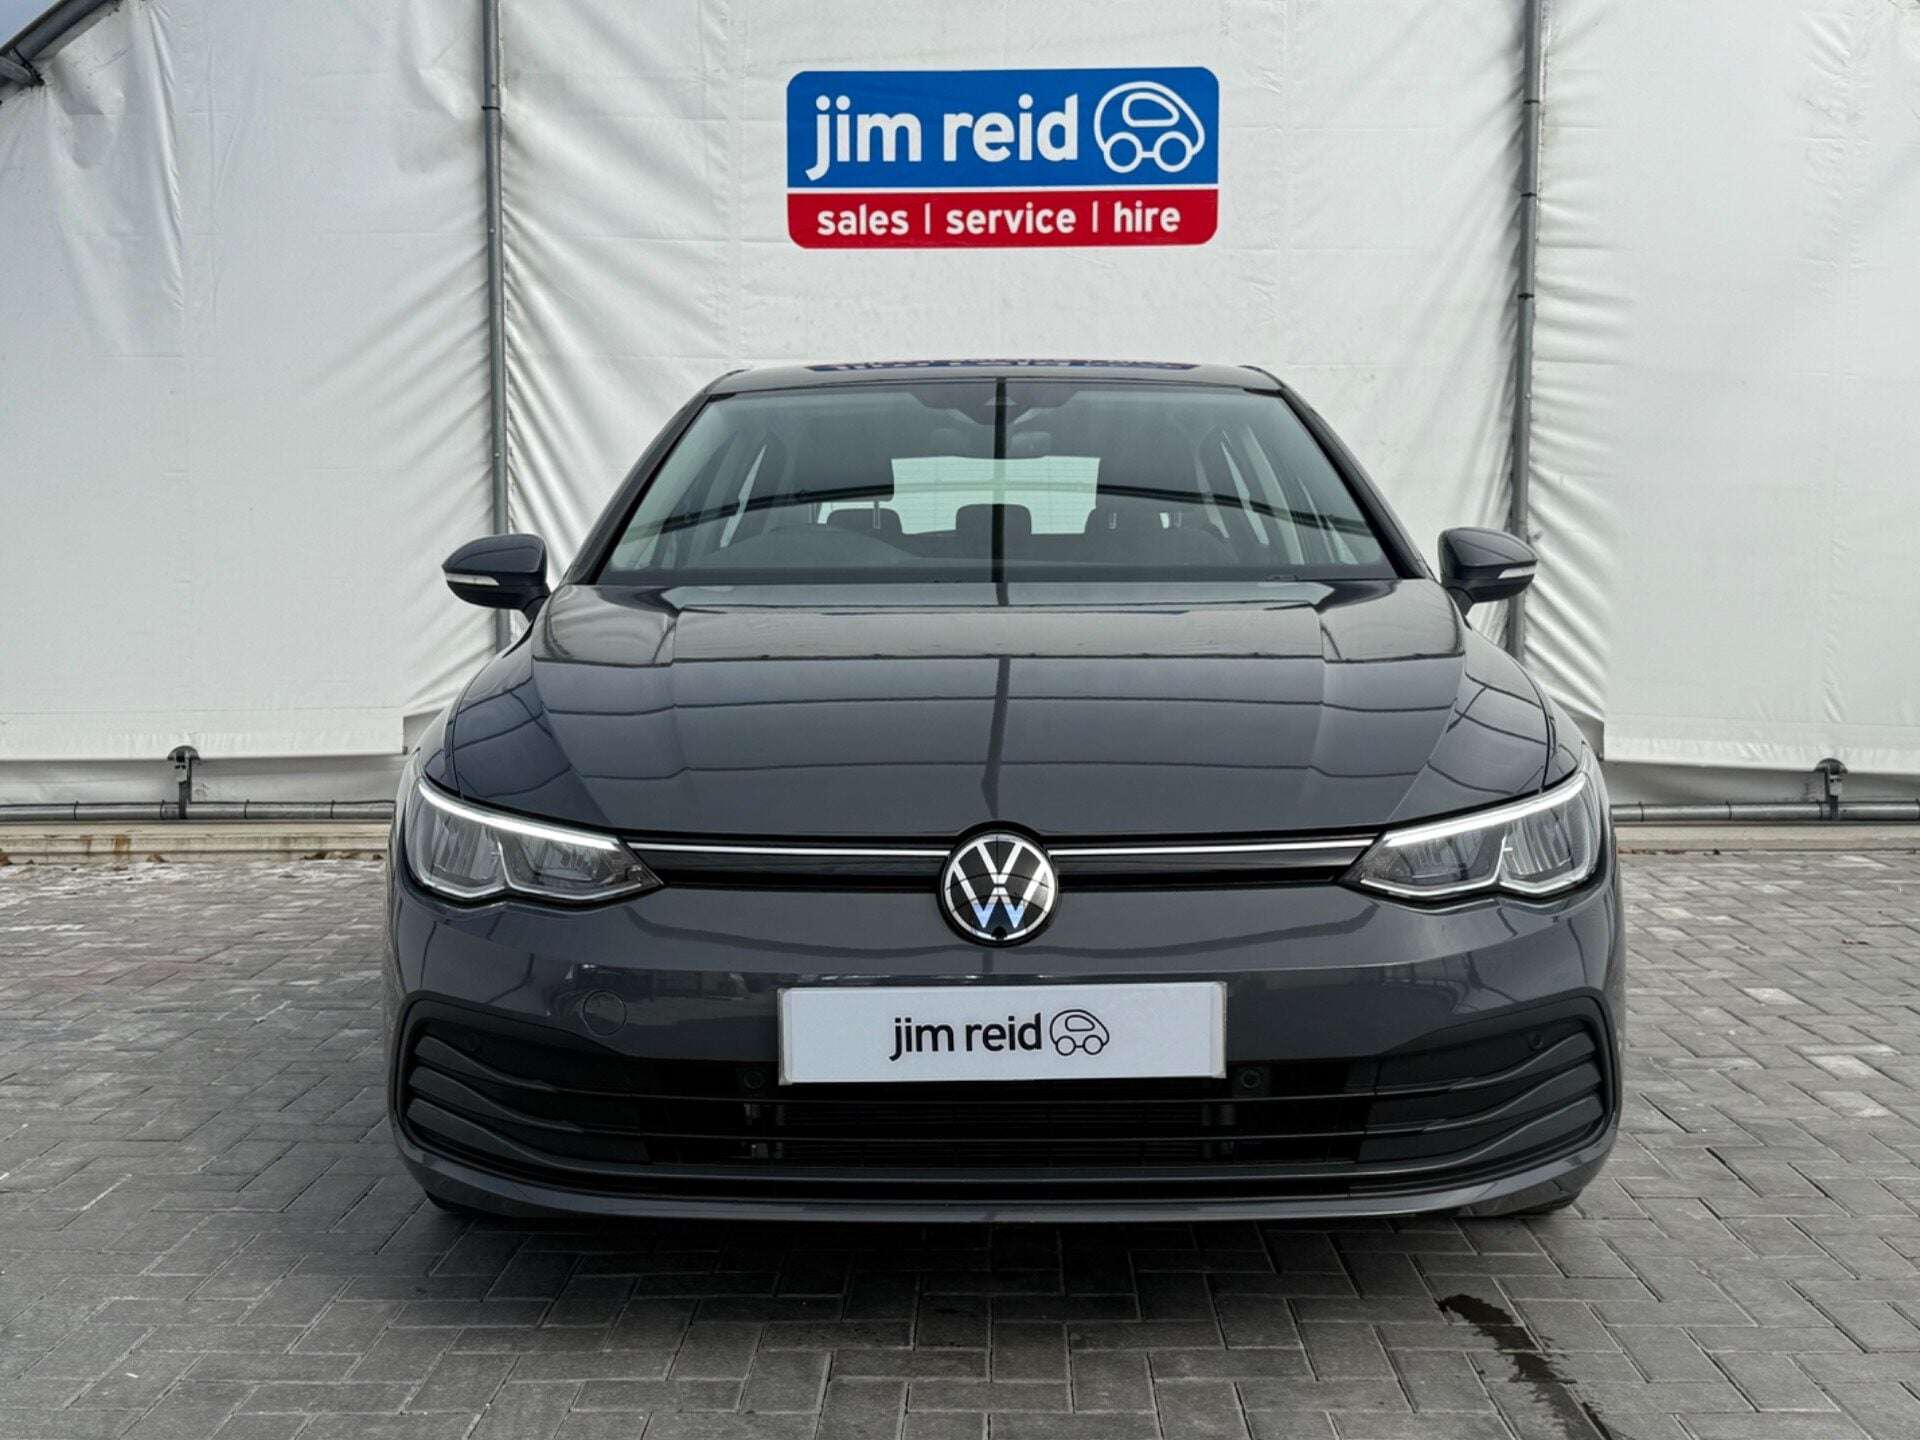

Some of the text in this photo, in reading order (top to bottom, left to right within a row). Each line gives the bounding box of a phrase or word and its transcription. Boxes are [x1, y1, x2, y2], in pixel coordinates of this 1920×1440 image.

[805, 93, 1079, 181] jim reid
[817, 200, 1181, 236] sales service hire
[889, 1012, 1042, 1062] jim reid
